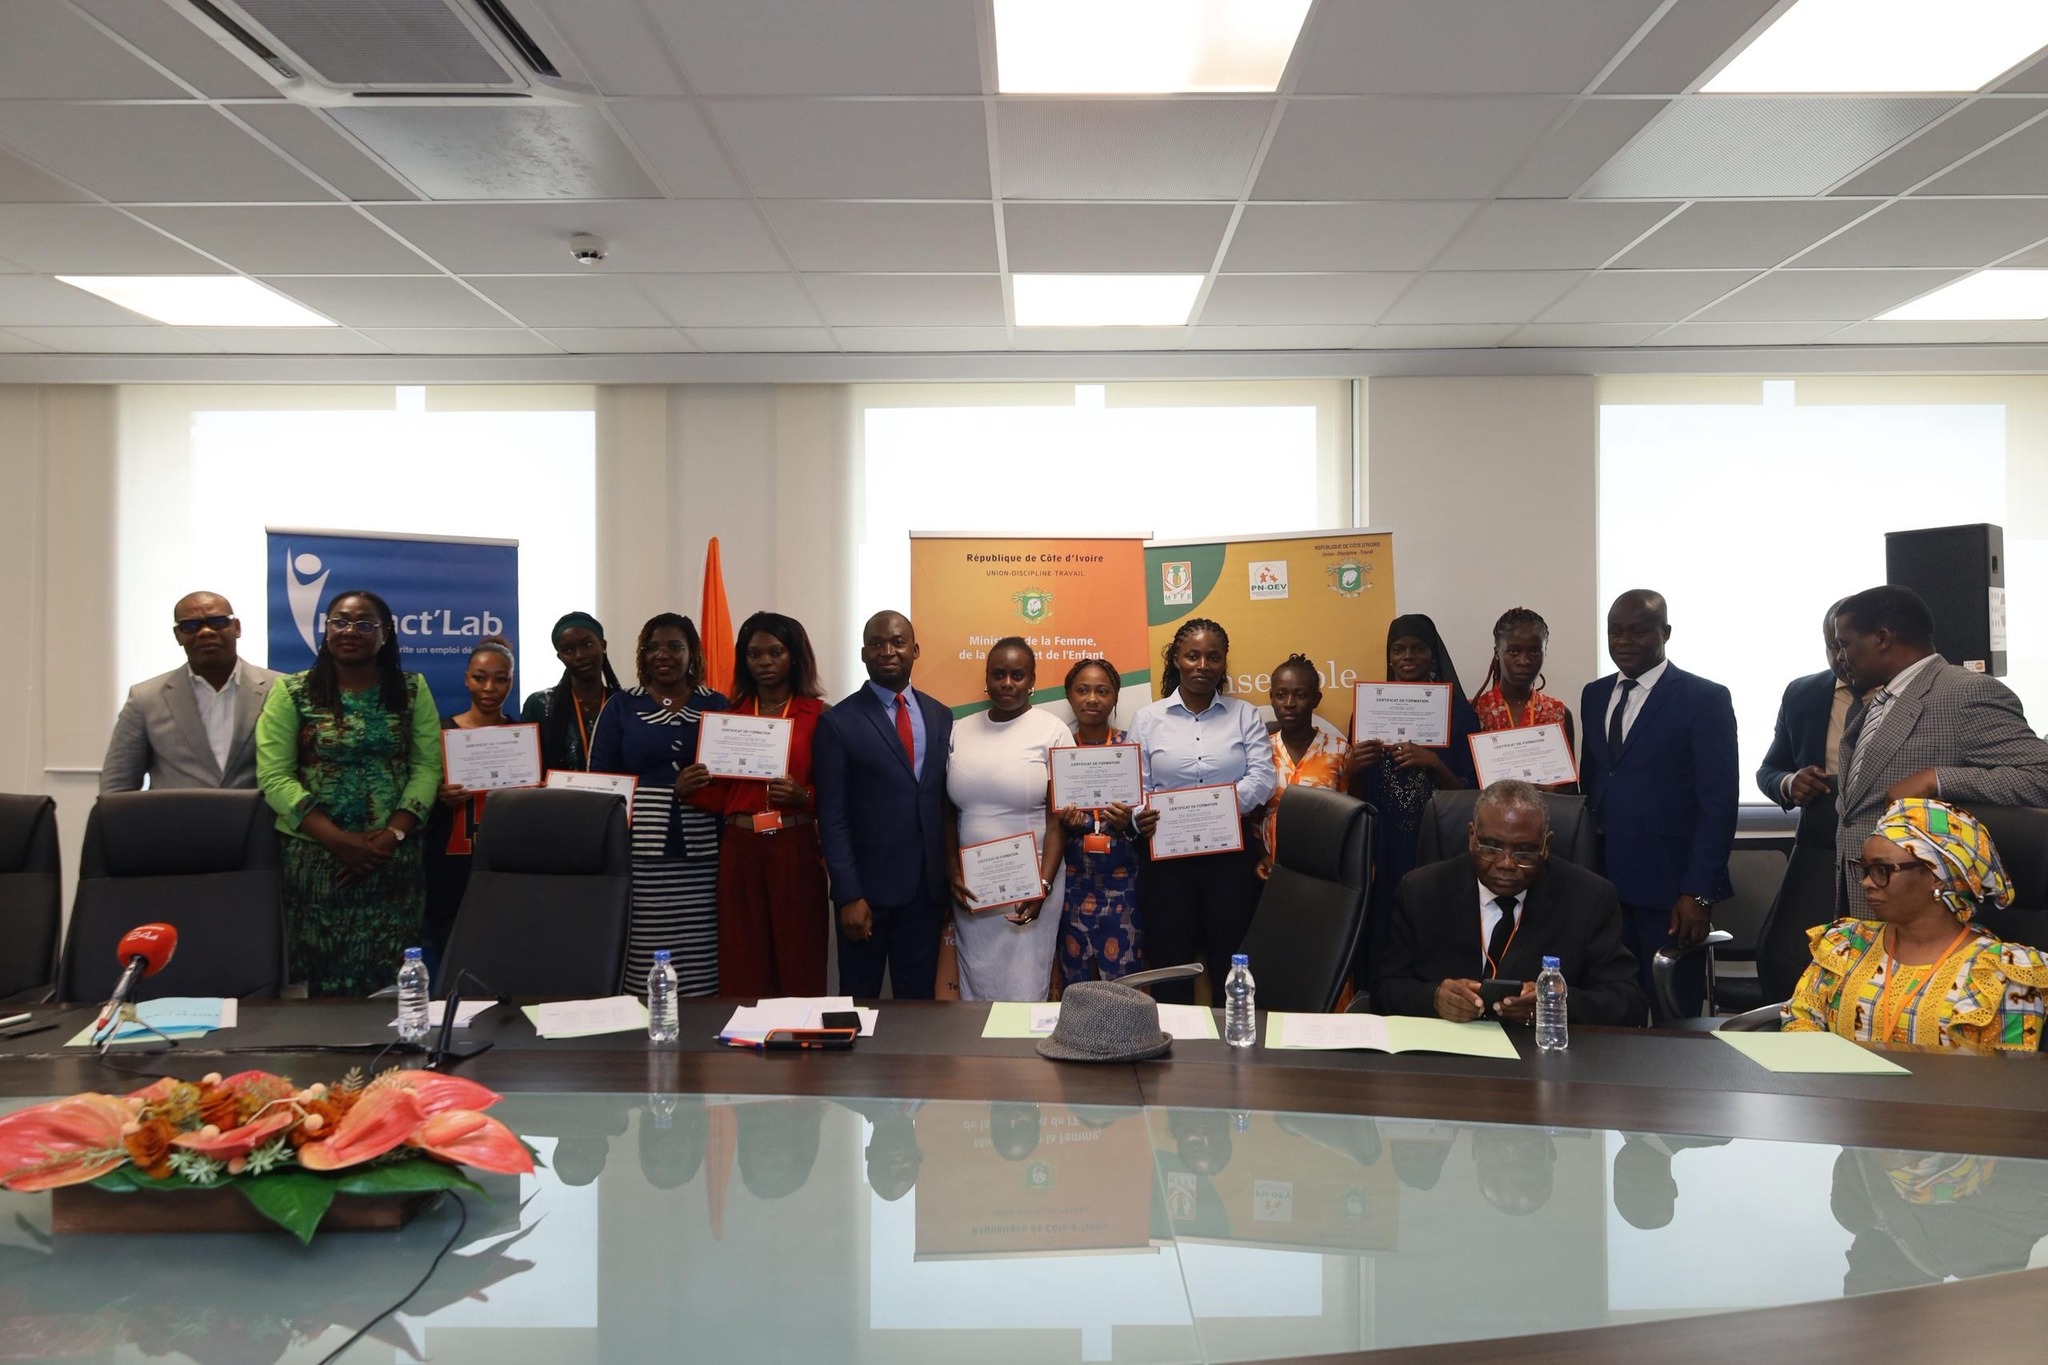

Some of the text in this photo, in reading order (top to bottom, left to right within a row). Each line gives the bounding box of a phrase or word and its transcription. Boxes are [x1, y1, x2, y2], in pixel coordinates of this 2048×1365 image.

[966, 553, 1104, 563] République de Côte d'Ivoire
[318, 609, 504, 636] ct'Lab
[969, 635, 1096, 647] Minis de la Femme,
[430, 646, 460, 655] emploi
[958, 650, 1104, 660] de la et de l'Enfant
